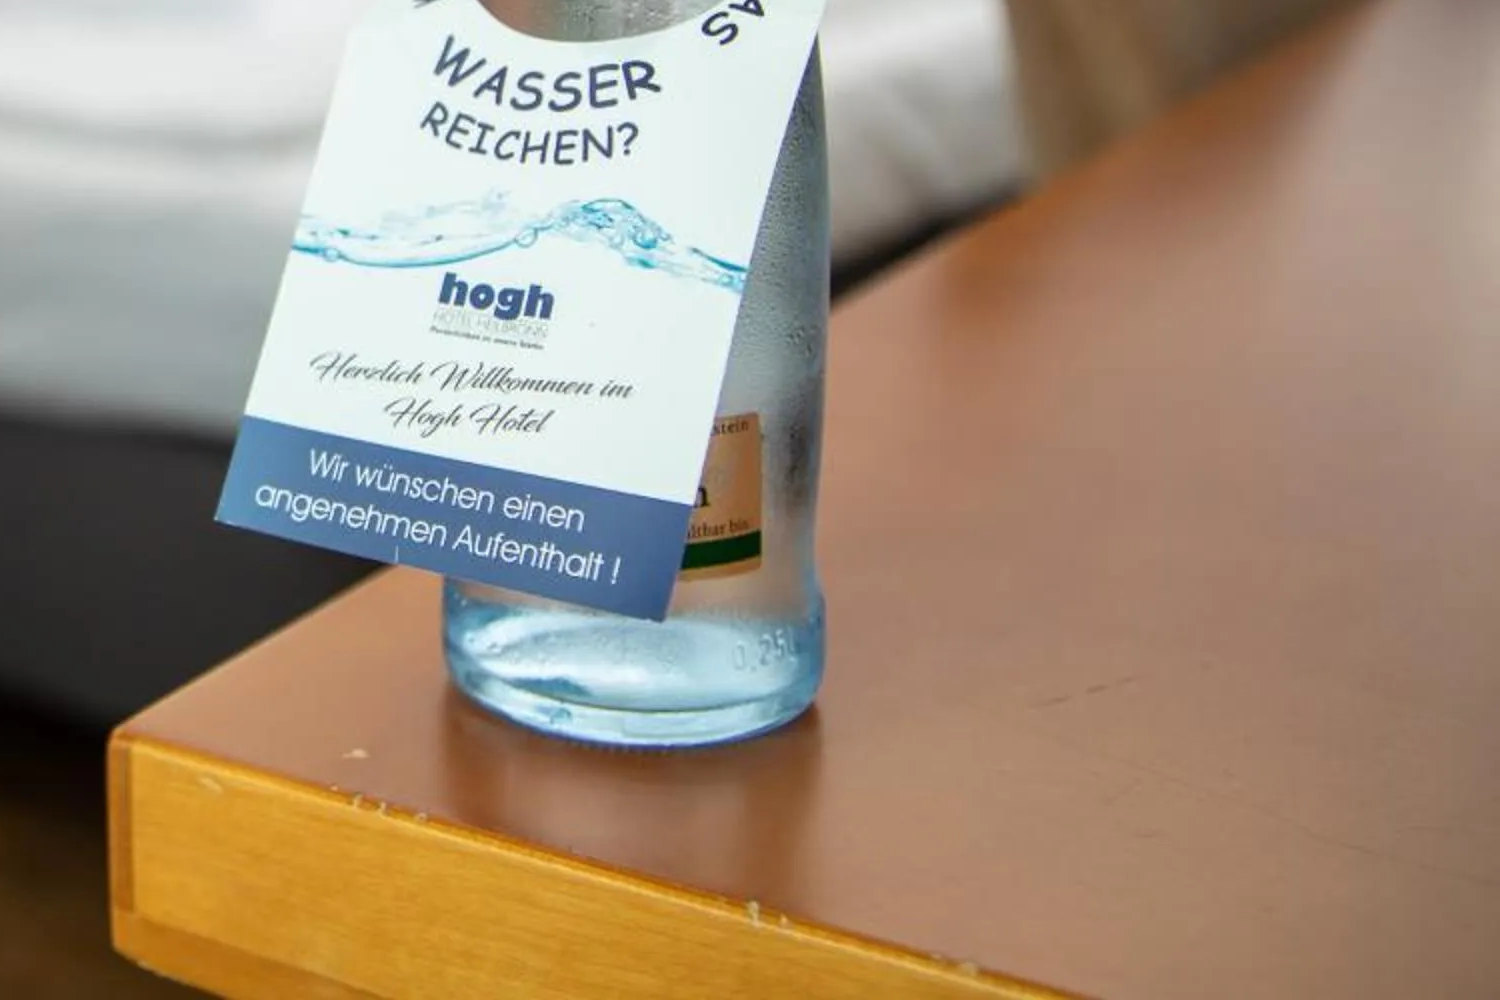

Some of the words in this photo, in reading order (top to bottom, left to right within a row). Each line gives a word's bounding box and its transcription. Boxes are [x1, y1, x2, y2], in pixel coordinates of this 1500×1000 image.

[433, 34, 662, 113] WASSER
[420, 101, 639, 166] REICHEN?
[438, 271, 556, 321] hogh
[309, 352, 423, 385] Herzlich
[430, 360, 595, 397] Willkommen
[598, 379, 634, 400] im
[383, 397, 462, 439] Hogh
[469, 403, 556, 436] Hotel
[309, 448, 349, 483] Wir
[355, 463, 495, 513] wünschen
[503, 495, 585, 533] einen
[255, 484, 447, 548] angenehmen
[452, 525, 605, 582] Aufenthalt
